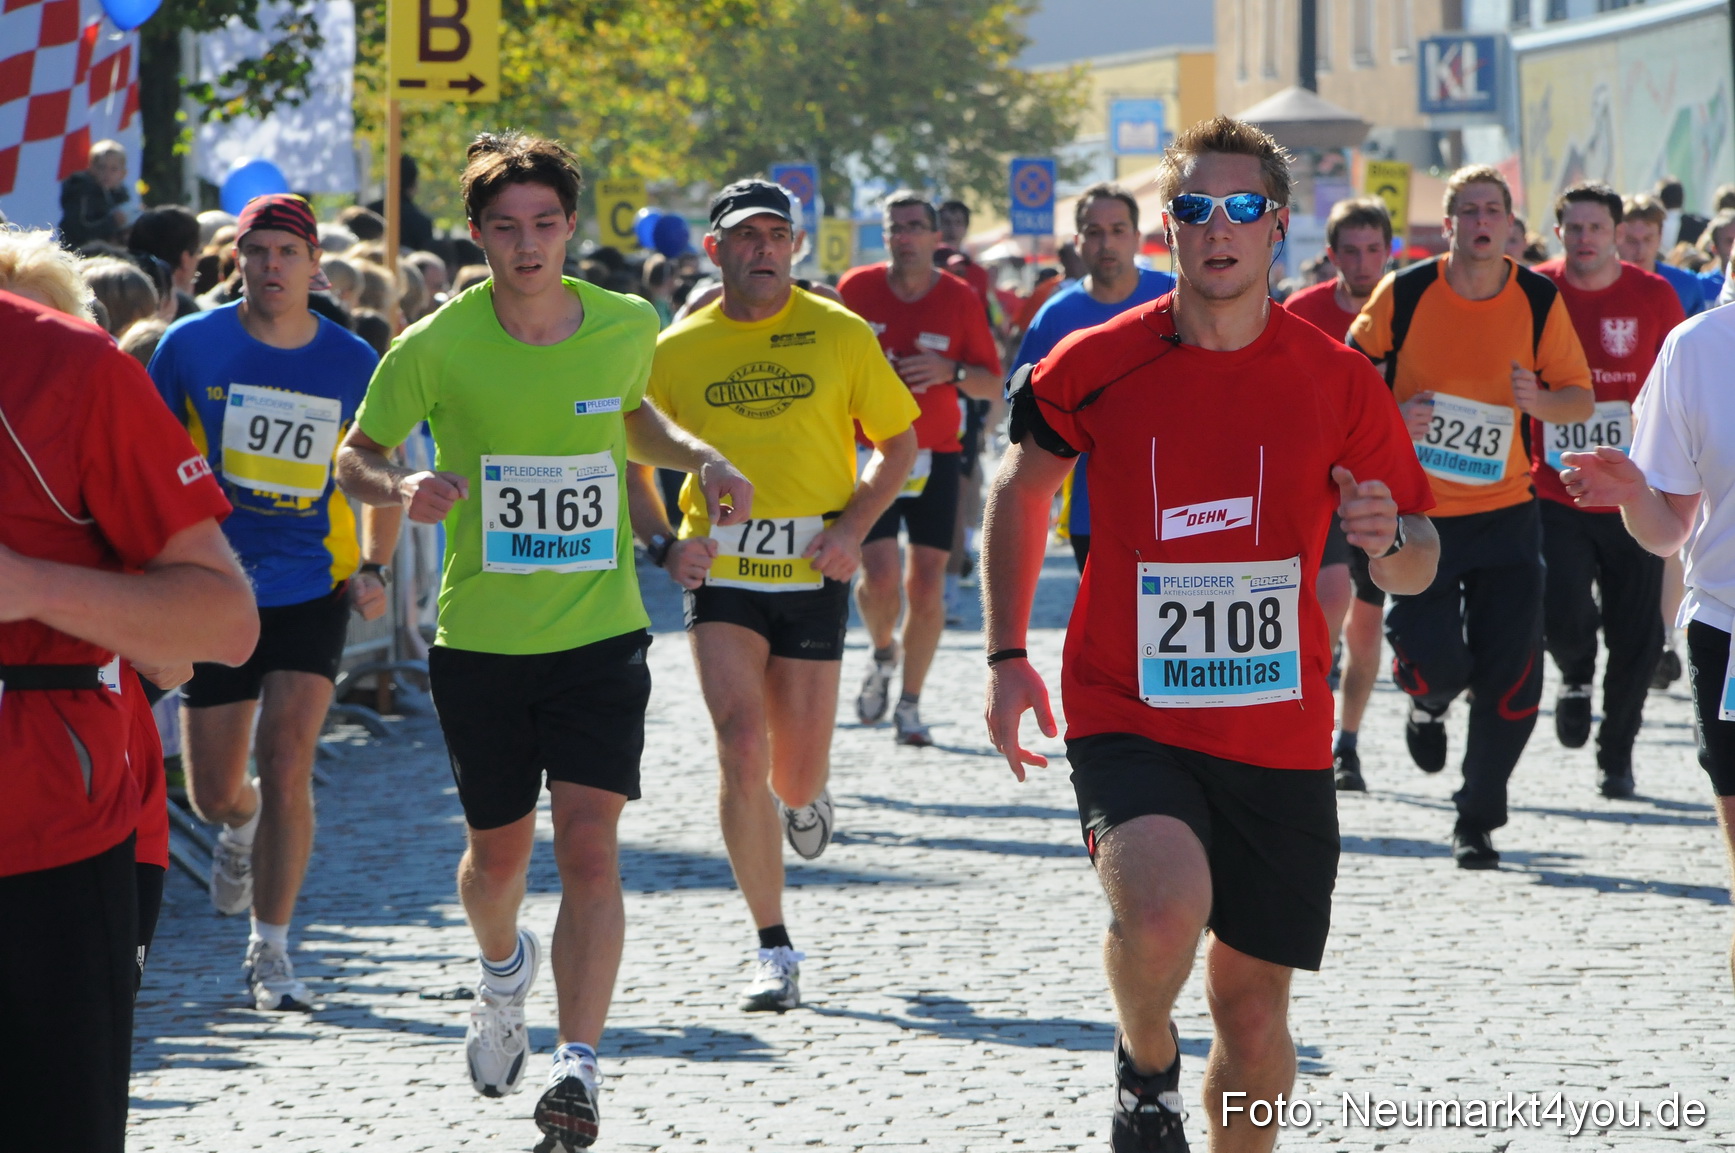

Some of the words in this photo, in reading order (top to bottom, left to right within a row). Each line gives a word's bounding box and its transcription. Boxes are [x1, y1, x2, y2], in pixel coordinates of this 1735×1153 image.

[418, 0, 471, 62] B
[610, 200, 636, 238] C
[719, 377, 801, 402] FRANCESCO
[248, 415, 315, 460] 976
[1426, 416, 1501, 457] 3243
[1555, 421, 1621, 450] 3046
[503, 466, 563, 478] PFLEIDERER
[1417, 446, 1499, 476] Waldemar
[499, 485, 603, 531] 3163
[1186, 508, 1228, 527] DEHN
[511, 534, 591, 559] Markus
[738, 519, 794, 555] 721
[738, 557, 793, 578] Bruno
[1163, 576, 1234, 588] PFLEIDERER
[1250, 575, 1289, 588] BOCK
[1158, 597, 1282, 654] 2108
[1164, 659, 1281, 688] Matthias
